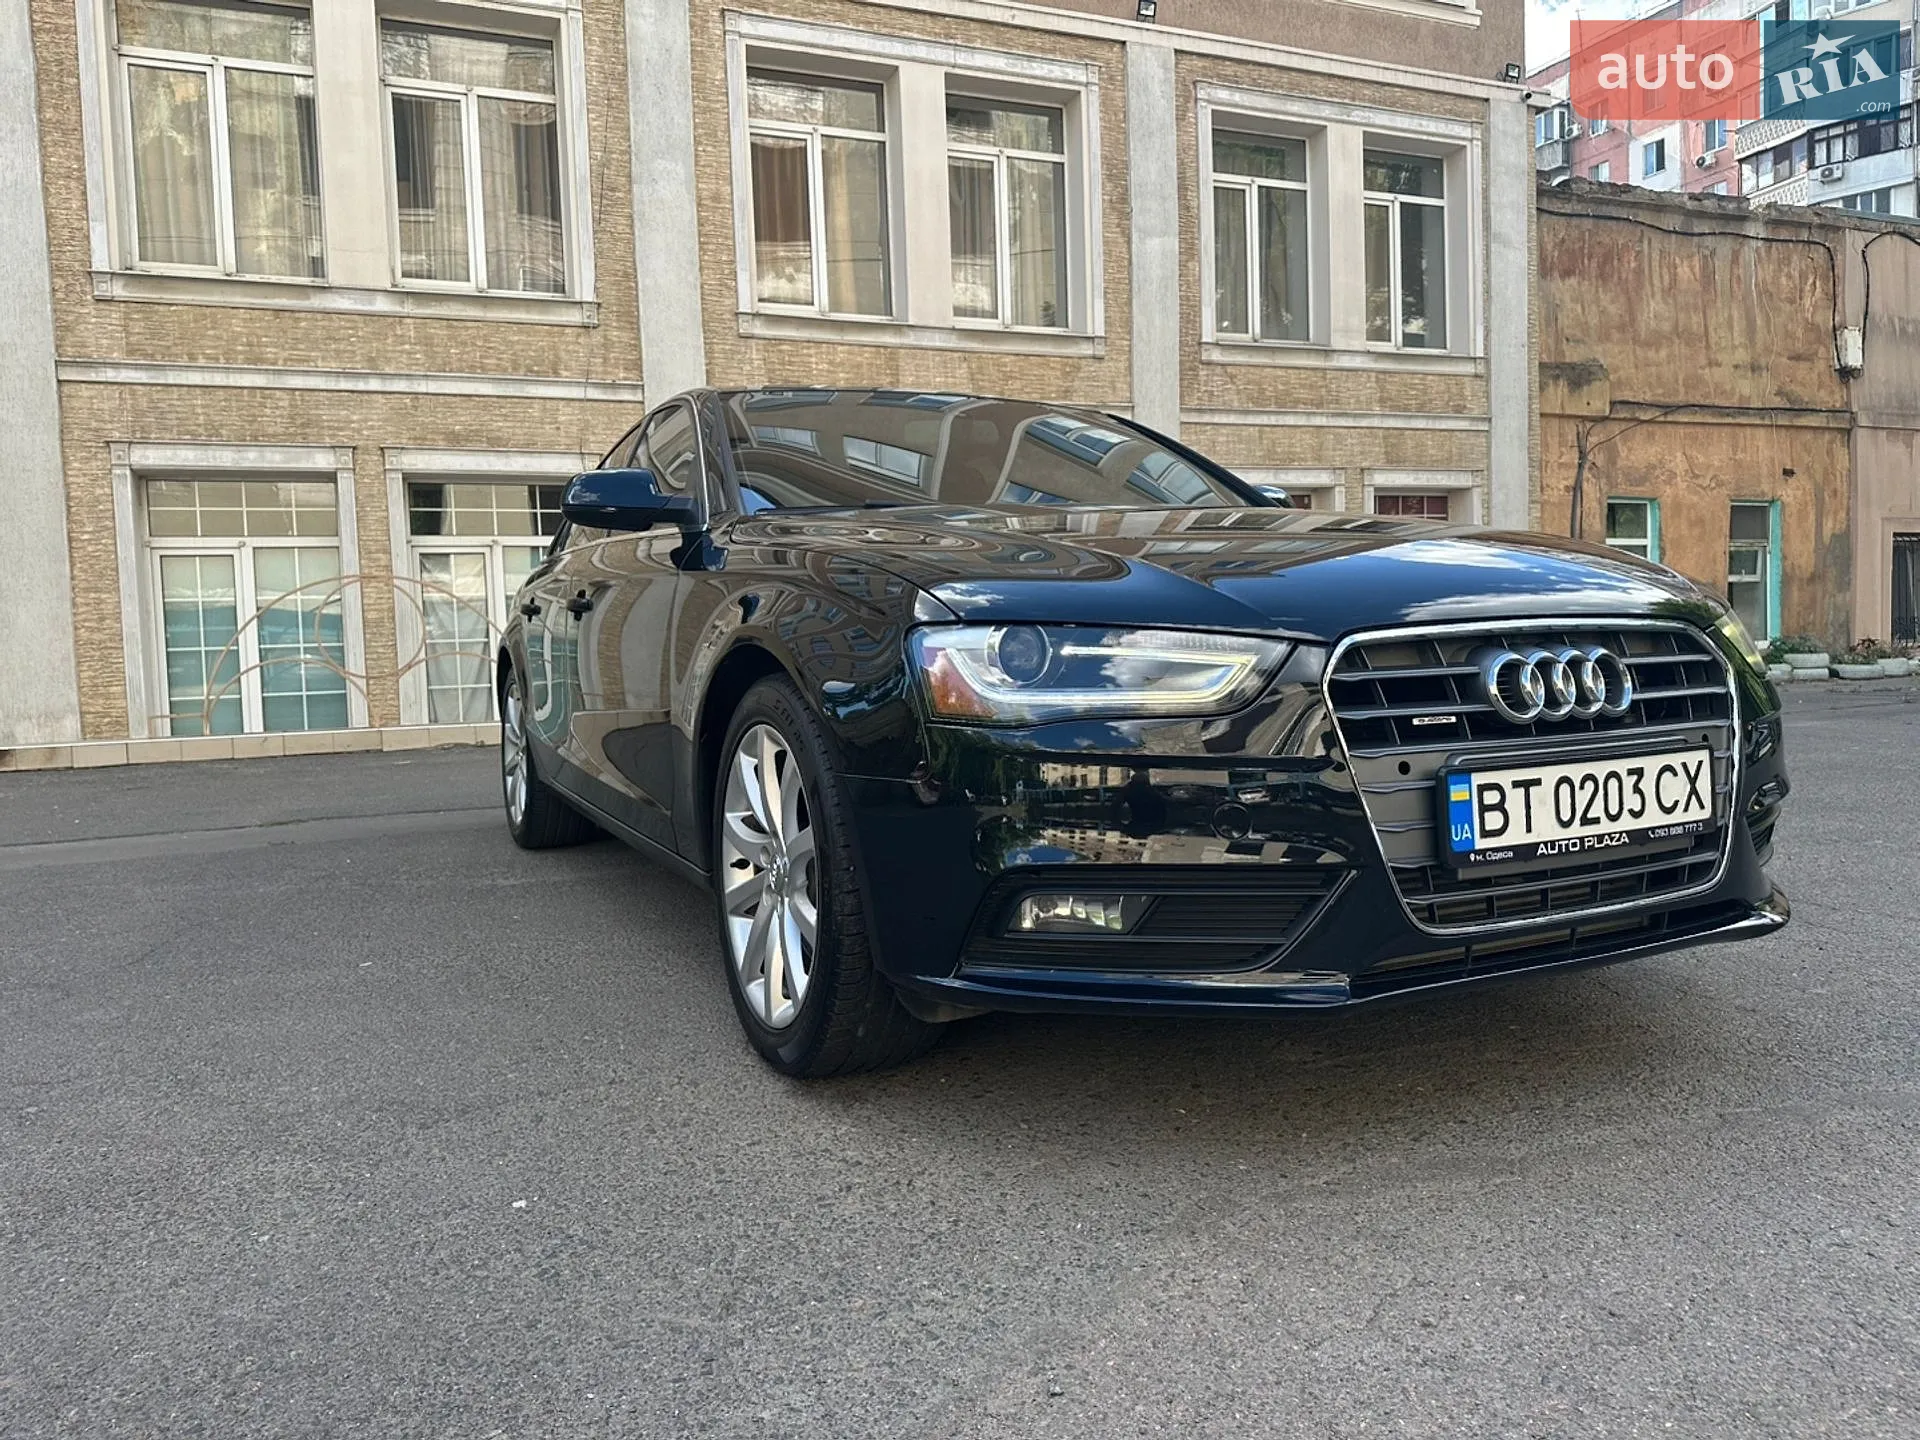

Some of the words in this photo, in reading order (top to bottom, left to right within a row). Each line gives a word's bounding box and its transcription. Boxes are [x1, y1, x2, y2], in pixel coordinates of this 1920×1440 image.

[1476, 777, 1543, 839] BT
[1553, 766, 1646, 829] 0203
[1655, 759, 1706, 815] CX
[1451, 823, 1473, 841] UA
[1536, 839, 1580, 856] AUTO
[1584, 832, 1630, 850] PLAZA
